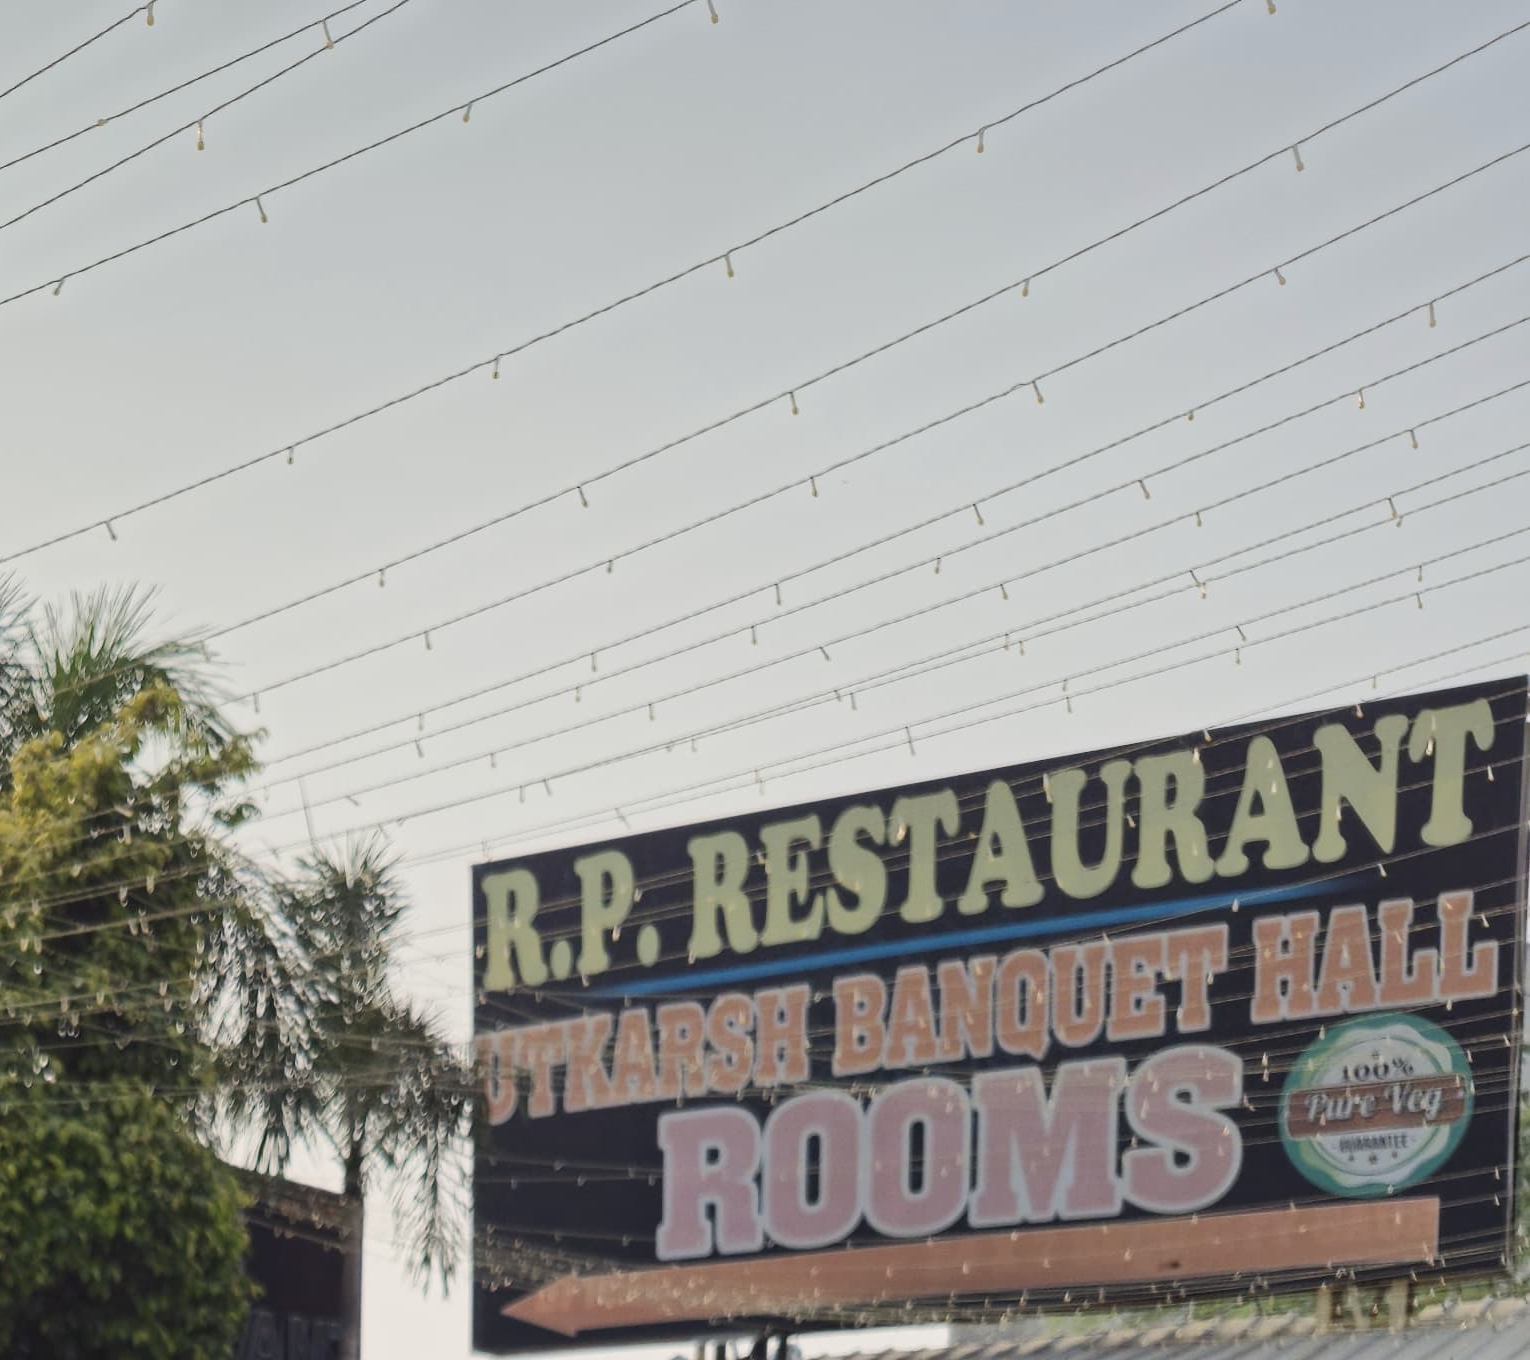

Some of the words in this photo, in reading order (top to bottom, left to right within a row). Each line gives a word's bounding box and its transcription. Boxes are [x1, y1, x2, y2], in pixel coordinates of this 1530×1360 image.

[480, 868, 660, 991] R.P.
[687, 698, 1497, 960] RESTAURANT
[473, 984, 810, 1126] UTKARSH
[832, 923, 1229, 1077] BANQUET
[1250, 889, 1500, 1026] HALL
[1342, 1056, 1414, 1083] 100%
[656, 1045, 1244, 1262] ROOMS
[1304, 1093, 1377, 1123] Pure
[1384, 1081, 1442, 1121] Veg
[1339, 1132, 1409, 1153] GUARANTEE
